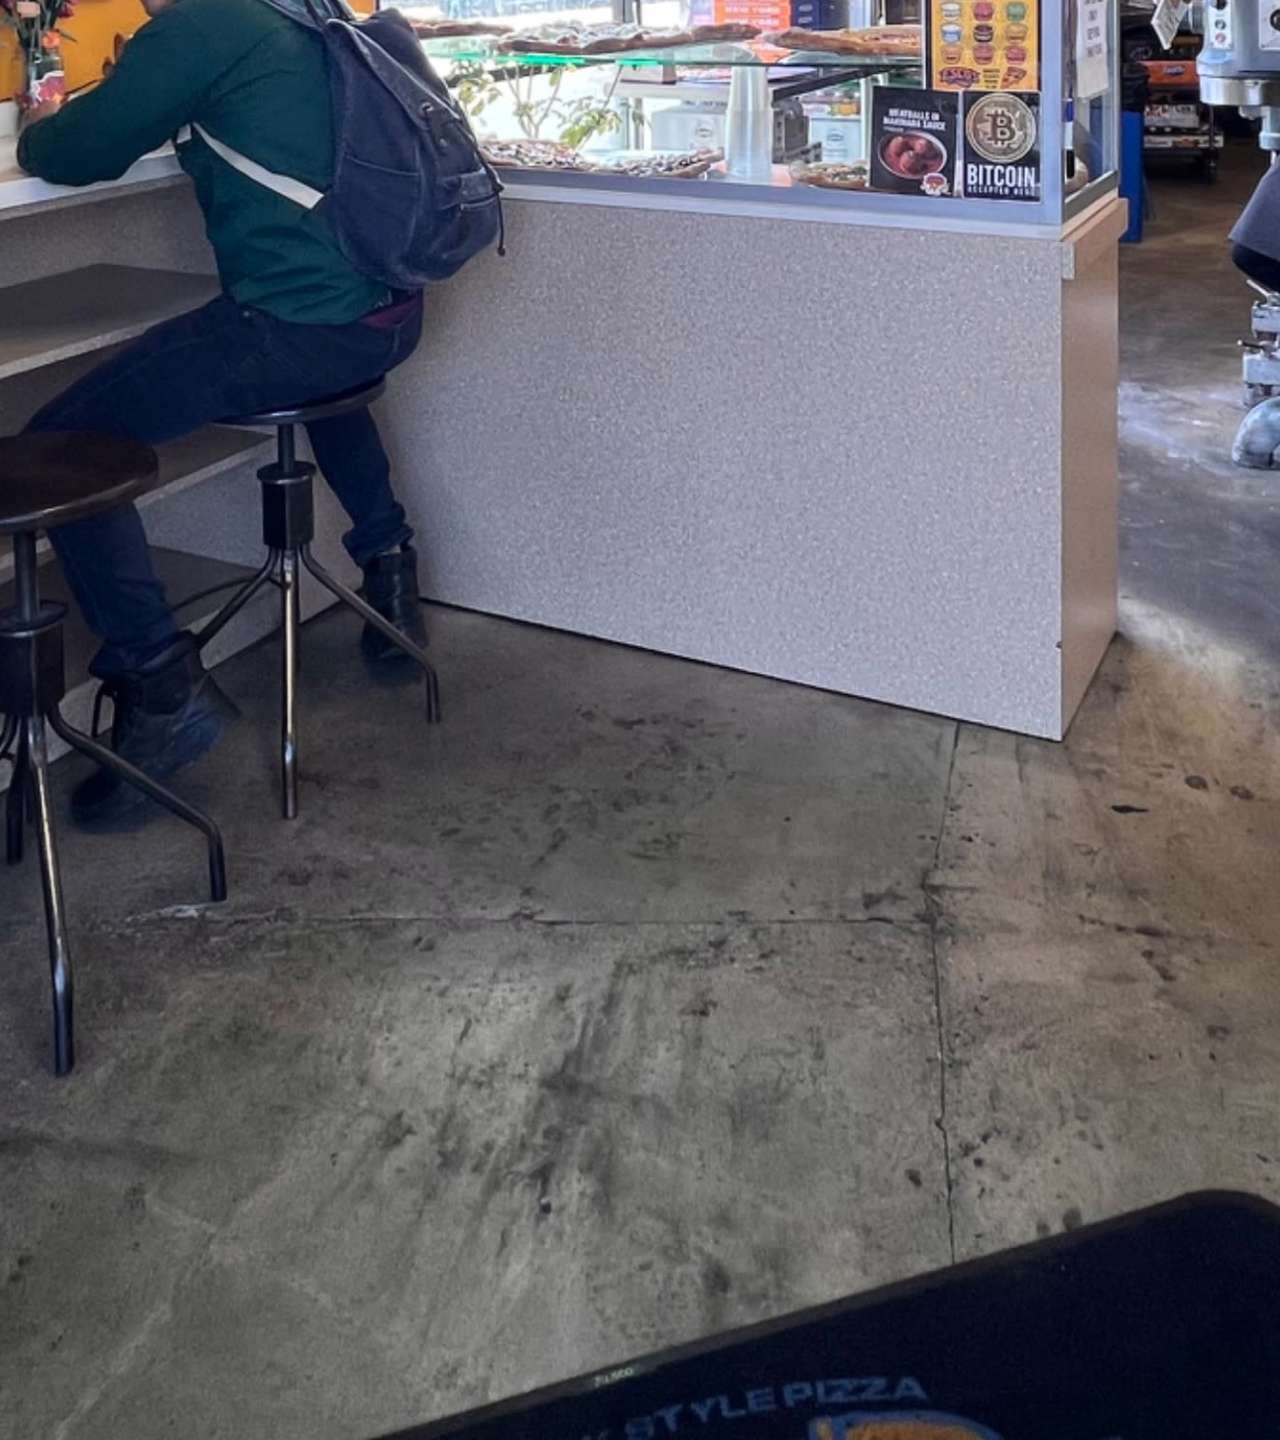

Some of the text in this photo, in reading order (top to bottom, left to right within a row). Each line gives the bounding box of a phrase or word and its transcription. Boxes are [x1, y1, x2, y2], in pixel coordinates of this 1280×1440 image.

[967, 163, 1035, 188] BITCOIN
[625, 1376, 928, 1440] STYLE PIZZA
